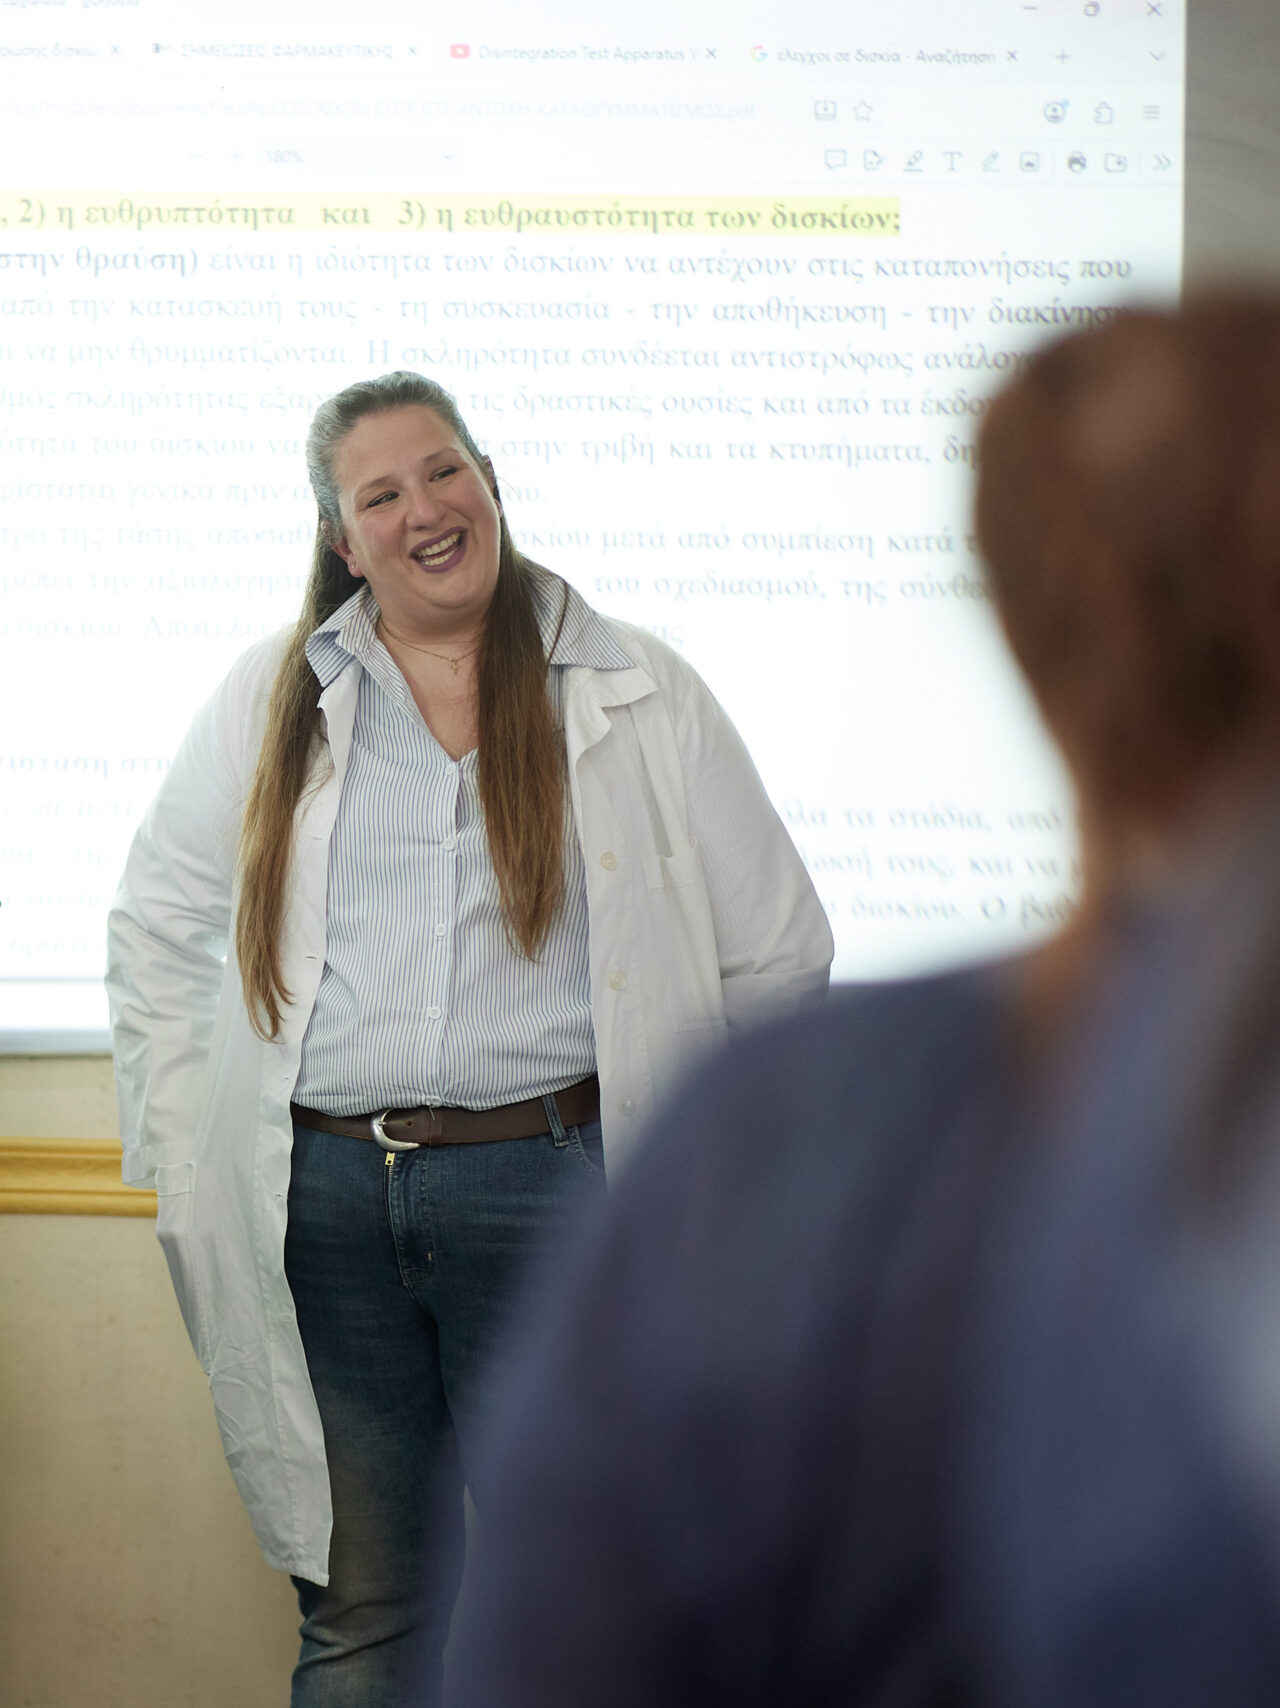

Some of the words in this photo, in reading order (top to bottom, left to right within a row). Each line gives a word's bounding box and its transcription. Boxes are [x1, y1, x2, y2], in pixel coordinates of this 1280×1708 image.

[479, 45, 578, 64] Disintegration
[582, 46, 609, 61] Test
[613, 46, 686, 64] Apparatus
[17, 198, 47, 229] 2)
[56, 205, 75, 230] η
[84, 197, 296, 231] ευθρυπτότητα
[320, 206, 372, 227] και
[397, 200, 426, 232] 3)
[434, 207, 454, 233] η
[463, 199, 695, 234] ευθραυστότητα
[704, 208, 761, 229] των
[769, 202, 901, 235] δισκίων;
[75, 244, 199, 279] θραύση)
[209, 244, 276, 272] είναι
[288, 254, 304, 279] η
[315, 244, 432, 280] ιδιότητα
[442, 253, 495, 273] των
[503, 245, 614, 274] δισκίων
[624, 255, 659, 274] να
[668, 248, 797, 283] αντέχουν
[807, 257, 864, 284] στις
[875, 250, 1071, 285] καταπονήσεις
[1080, 260, 1133, 279] που
[0, 290, 54, 316] από
[69, 298, 117, 323] την
[128, 291, 283, 324] κατασκευή
[297, 299, 358, 325] τους
[399, 300, 429, 325] τη
[442, 293, 612, 321] συσκευασία
[652, 302, 700, 327] την
[711, 297, 888, 331] αποθήκευση
[928, 302, 976, 331] την
[987, 297, 1130, 332] διακίνησ
[24, 345, 58, 363] να
[68, 345, 121, 370] μην
[367, 339, 391, 365] Η
[401, 338, 572, 372] σκληρότητα
[581, 340, 721, 368] συνδέεται
[730, 343, 915, 377] αντιστρόφως
[65, 382, 250, 416] σκληρότητας
[513, 385, 654, 420] δραστικές
[662, 387, 753, 422] ουσίες
[763, 396, 808, 416] και
[817, 387, 871, 417] από
[881, 397, 913, 417] τα
[89, 437, 139, 455] του
[149, 427, 256, 456] δισκίου
[501, 439, 568, 465] στην
[579, 431, 656, 466] τριβή
[669, 440, 714, 460] και
[726, 441, 757, 462] τα
[769, 433, 932, 471] κτυπήματα,
[127, 472, 215, 507] γενικά
[225, 481, 285, 508] πριν
[59, 526, 104, 552] της
[117, 519, 196, 552] τάσης
[601, 520, 667, 556] μετά
[677, 520, 732, 551] από
[741, 524, 875, 561] συμπίεση
[887, 525, 954, 553] κατά
[654, 567, 828, 605] σχεδιασμού,
[841, 577, 888, 607] της
